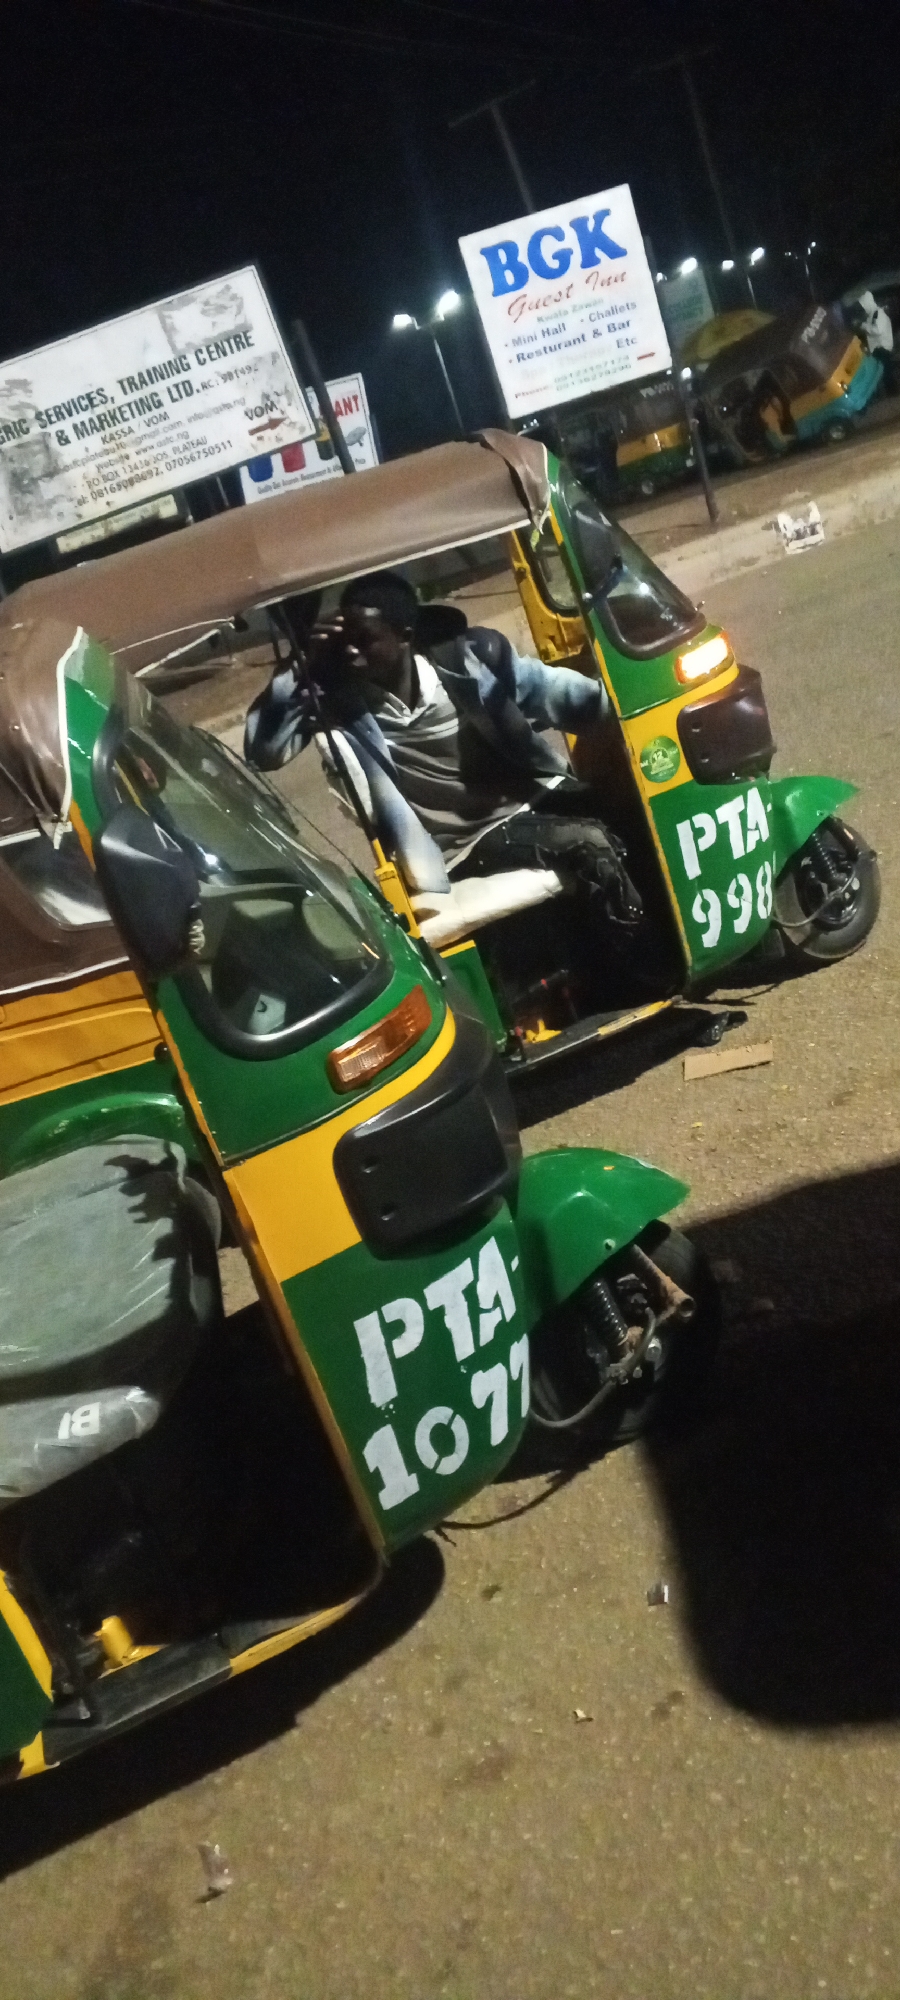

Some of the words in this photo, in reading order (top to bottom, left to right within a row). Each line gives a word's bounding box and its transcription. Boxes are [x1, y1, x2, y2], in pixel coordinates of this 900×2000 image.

[480, 208, 627, 297] BGK
[508, 284, 573, 323] Guest
[585, 271, 626, 290] Inn
[588, 301, 637, 323] Challets
[512, 333, 538, 348] Mini
[541, 323, 567, 339] Hall
[516, 333, 587, 363] Resturant
[592, 328, 602, 339] &
[607, 319, 631, 334] Bar
[616, 337, 638, 349] Etc
[35, 387, 116, 429] SERVICES,
[117, 355, 191, 397] TRAINING
[194, 330, 255, 366] CENTRE
[55, 425, 70, 447] &
[73, 392, 163, 440] MARKETING
[167, 379, 201, 404] LTD.
[244, 399, 278, 421] VOM
[334, 394, 359, 420] ANT
[100, 425, 135, 445] KASSA
[142, 412, 170, 430] VOM
[172, 435, 208, 460] PLATEAU
[692, 861, 773, 948] 998
[362, 1333, 530, 1511] 1077
